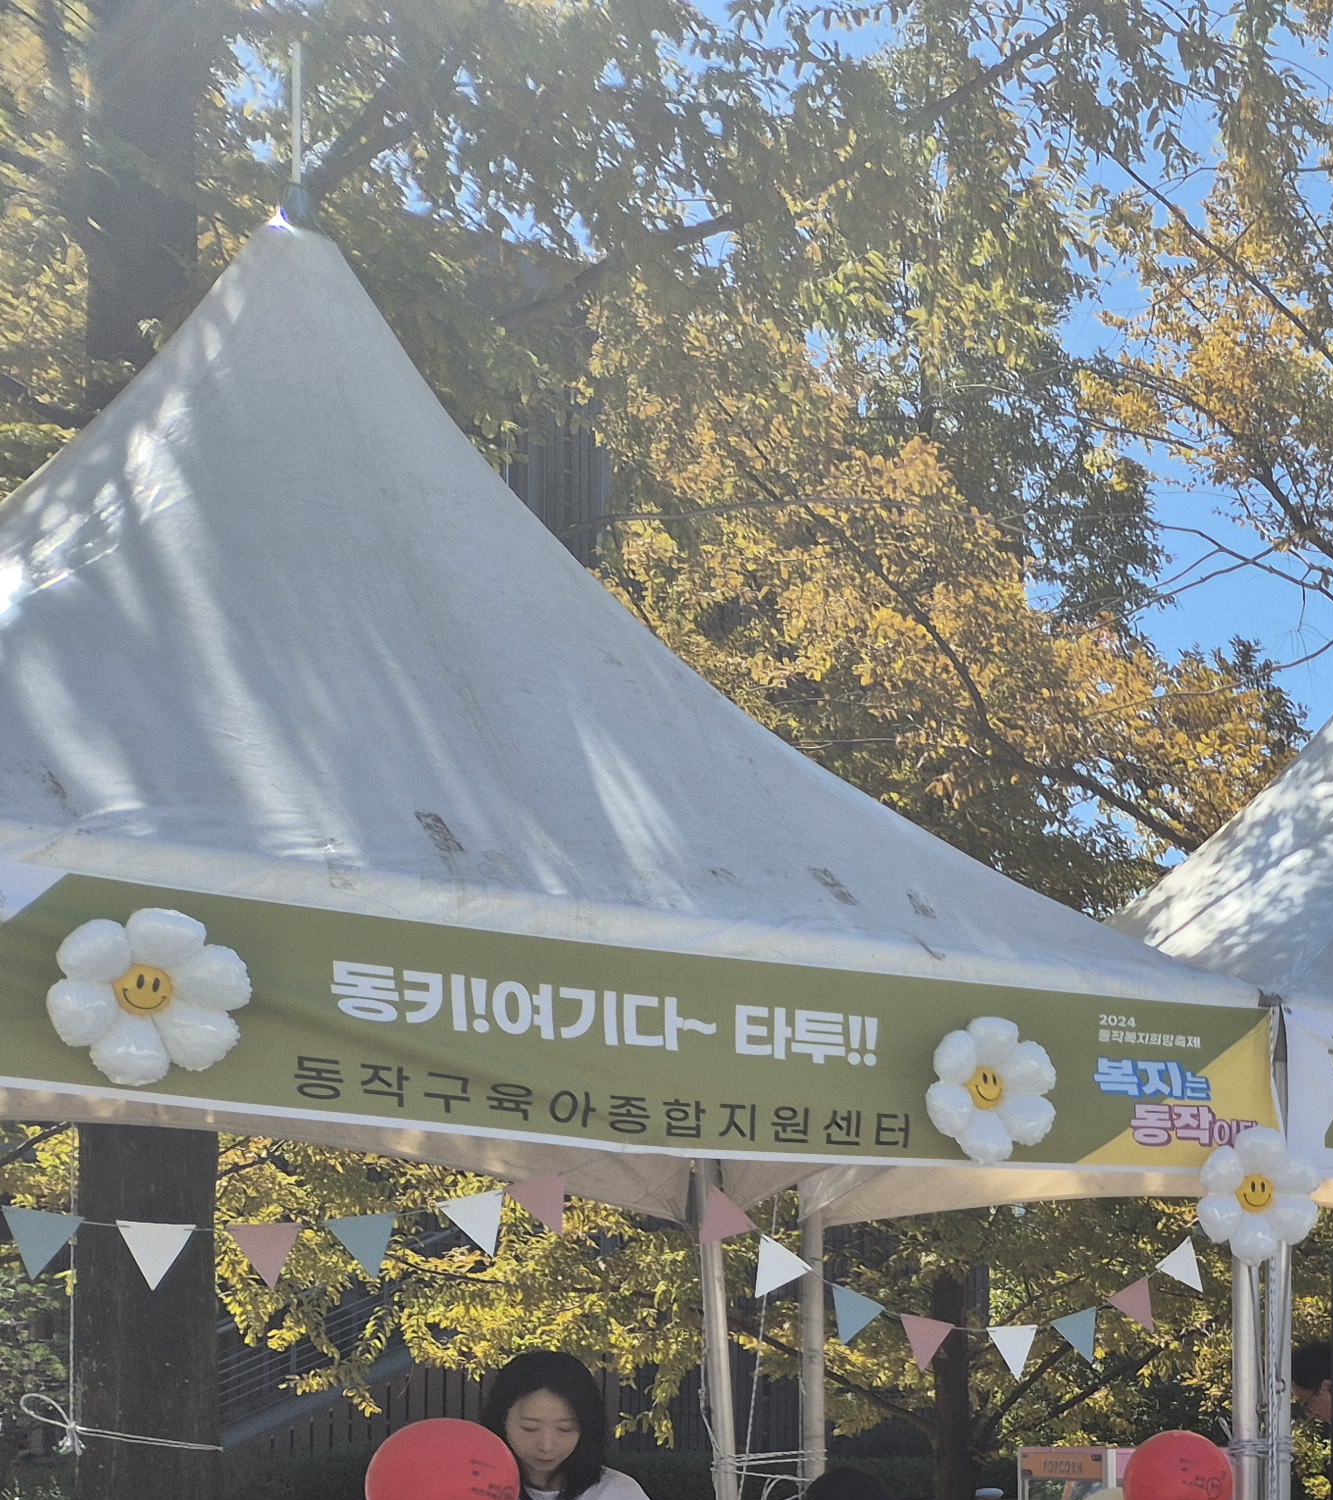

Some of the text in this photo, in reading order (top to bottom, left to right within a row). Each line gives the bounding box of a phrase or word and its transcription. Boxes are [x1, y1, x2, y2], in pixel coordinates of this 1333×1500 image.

[331, 960, 878, 1067] 동키!여기다~ 타투!!
[1098, 1014, 1136, 1028] 2024
[1098, 1029, 1201, 1049] 동작복지희망축제
[1093, 1056, 1212, 1101] 복지는
[294, 1055, 910, 1148] 동작구육아종합지원센터
